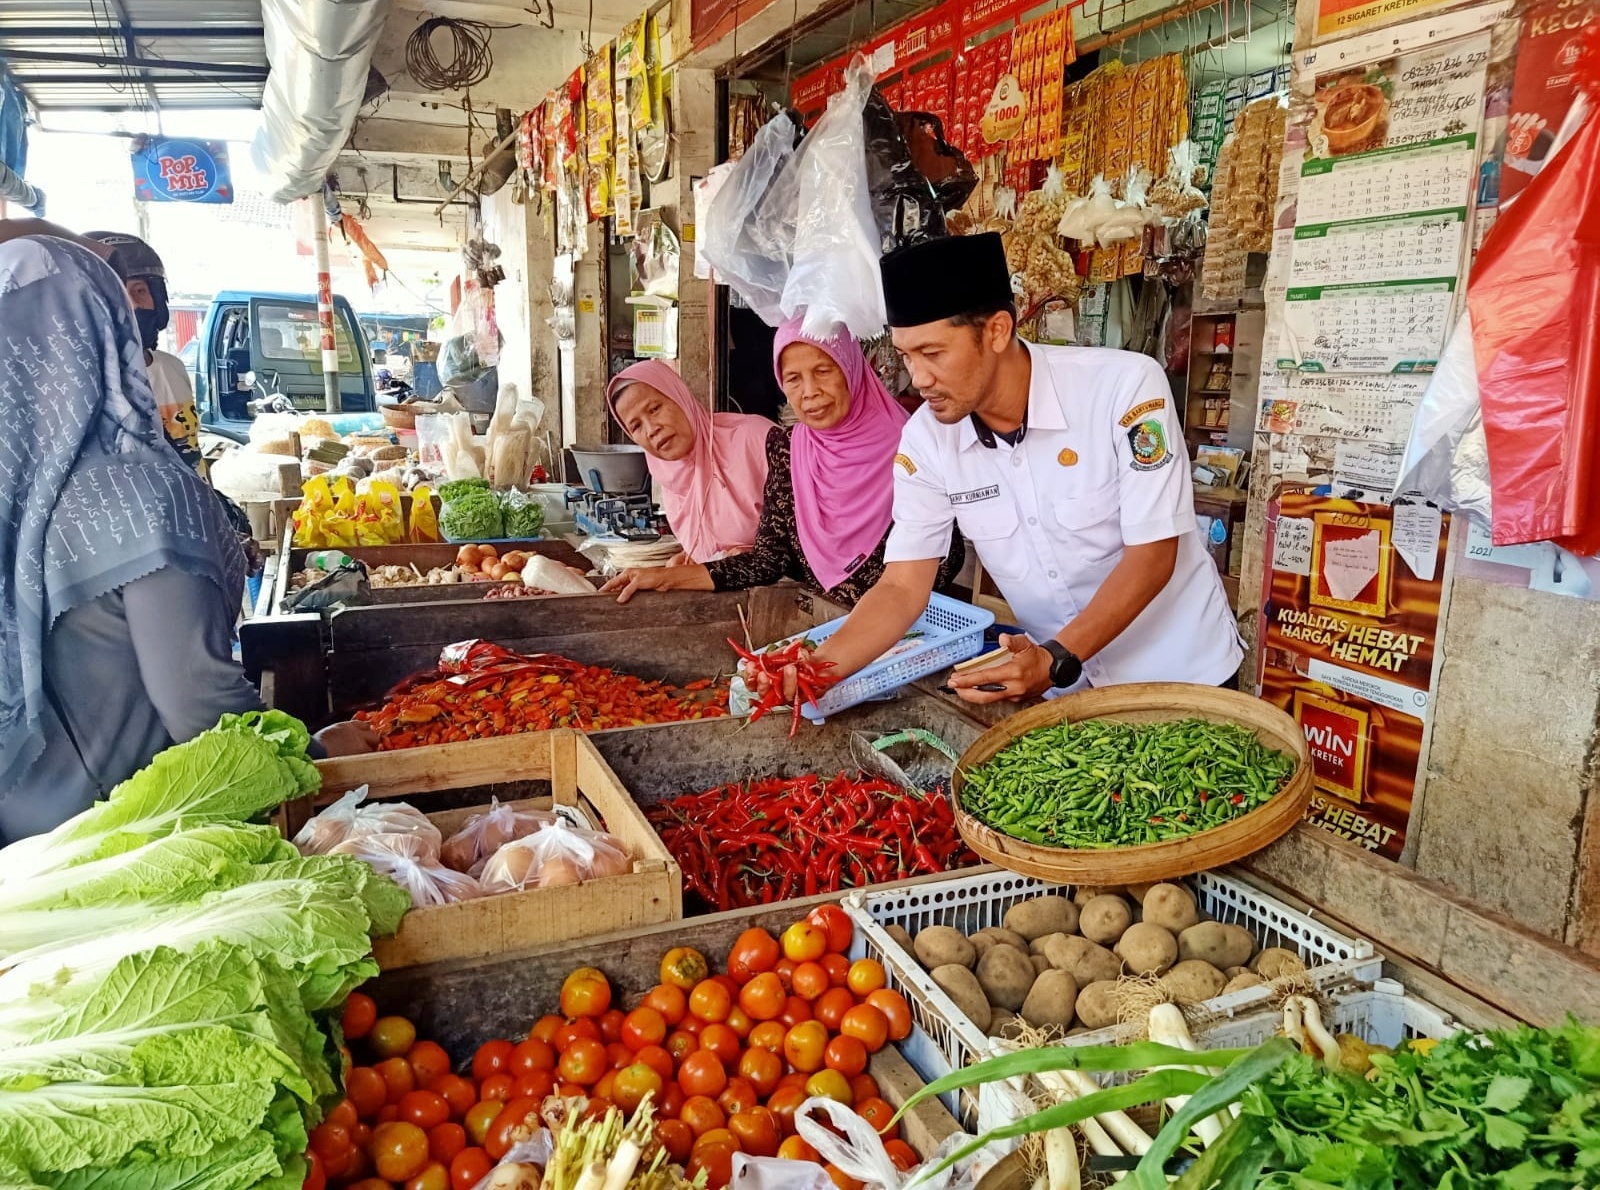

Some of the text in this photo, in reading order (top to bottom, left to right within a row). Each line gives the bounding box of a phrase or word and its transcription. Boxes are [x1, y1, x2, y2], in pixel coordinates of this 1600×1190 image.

[1337, 17, 1346, 25] 12
[1346, 6, 1381, 22] SIGARET
[994, 104, 1019, 122] 1000
[159, 156, 196, 178] POP
[168, 170, 208, 192] MIE
[1470, 546, 1493, 556] 2021
[1278, 608, 1425, 655] KUALITAS HEBAT
[1280, 624, 1408, 673] HARGA HEMAT
[1304, 723, 1353, 756] WIN
[1311, 747, 1344, 767] KRETEK
[1324, 804, 1397, 845] HEBAT
